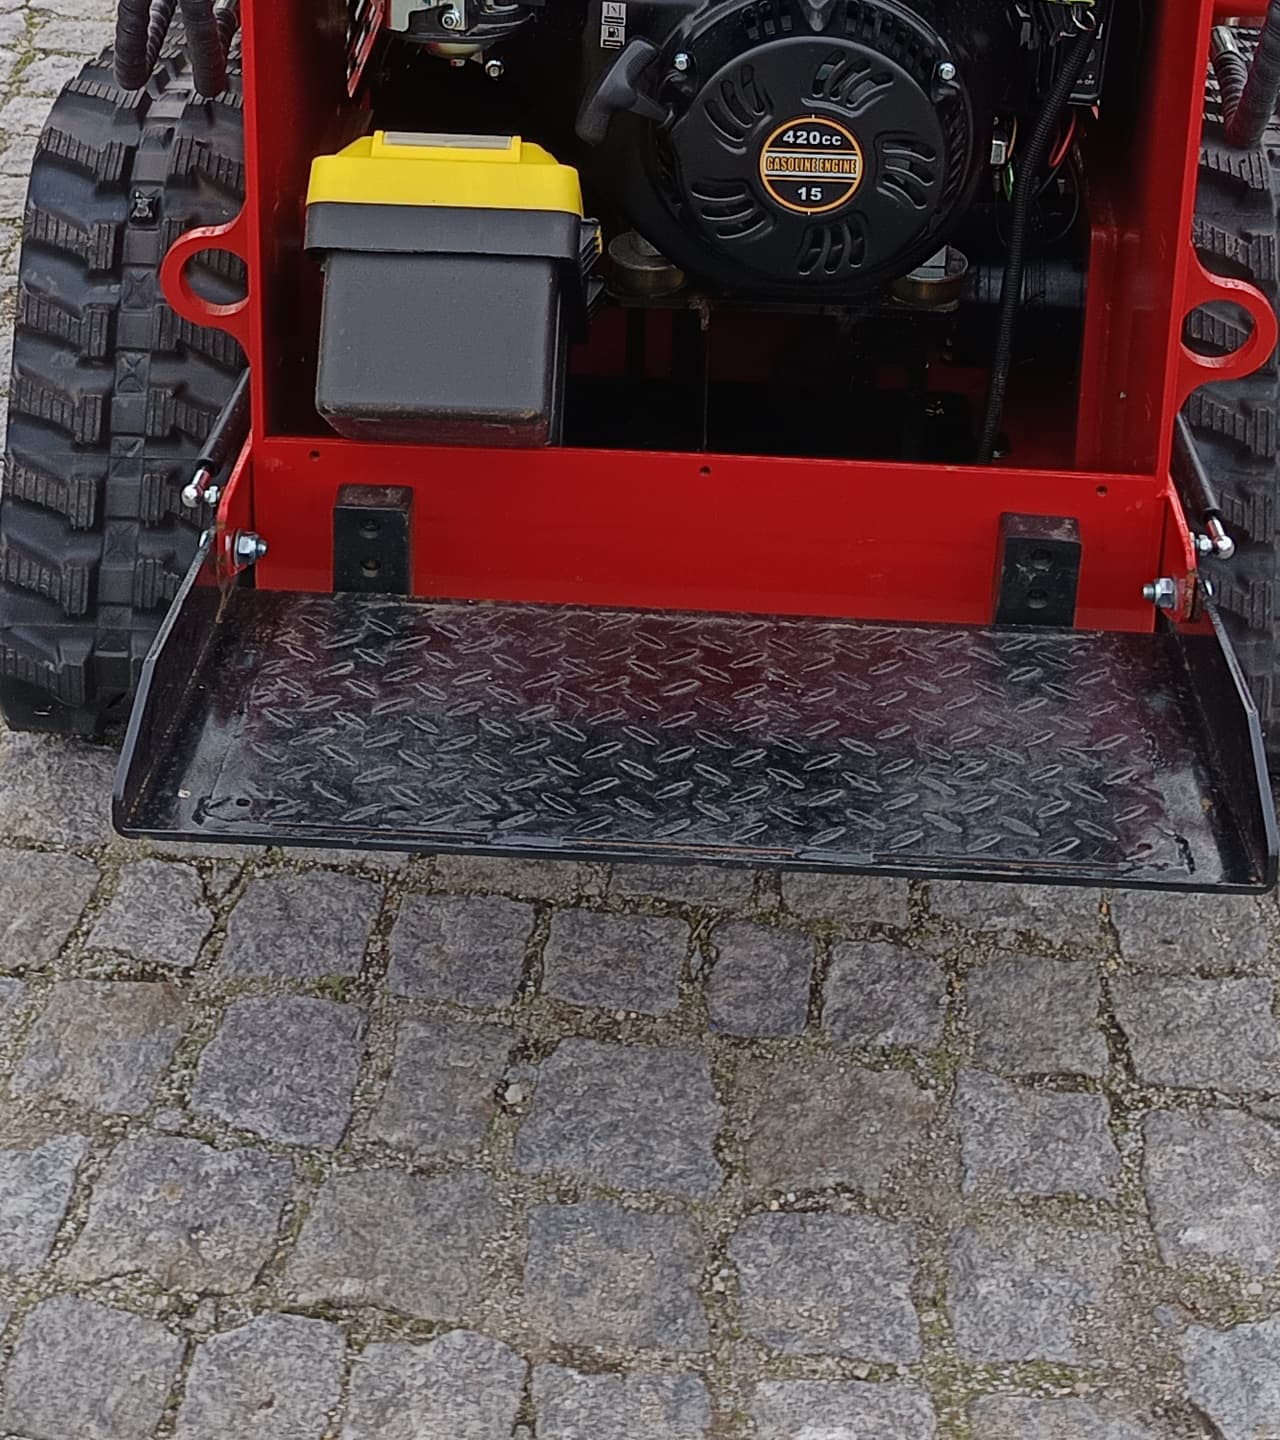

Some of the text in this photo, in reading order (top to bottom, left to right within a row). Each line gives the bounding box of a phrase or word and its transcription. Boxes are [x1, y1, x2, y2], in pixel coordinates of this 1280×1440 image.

[782, 130, 842, 146] 420cc
[766, 157, 857, 174] GASOLINE ENGINE
[797, 186, 823, 201] 15
